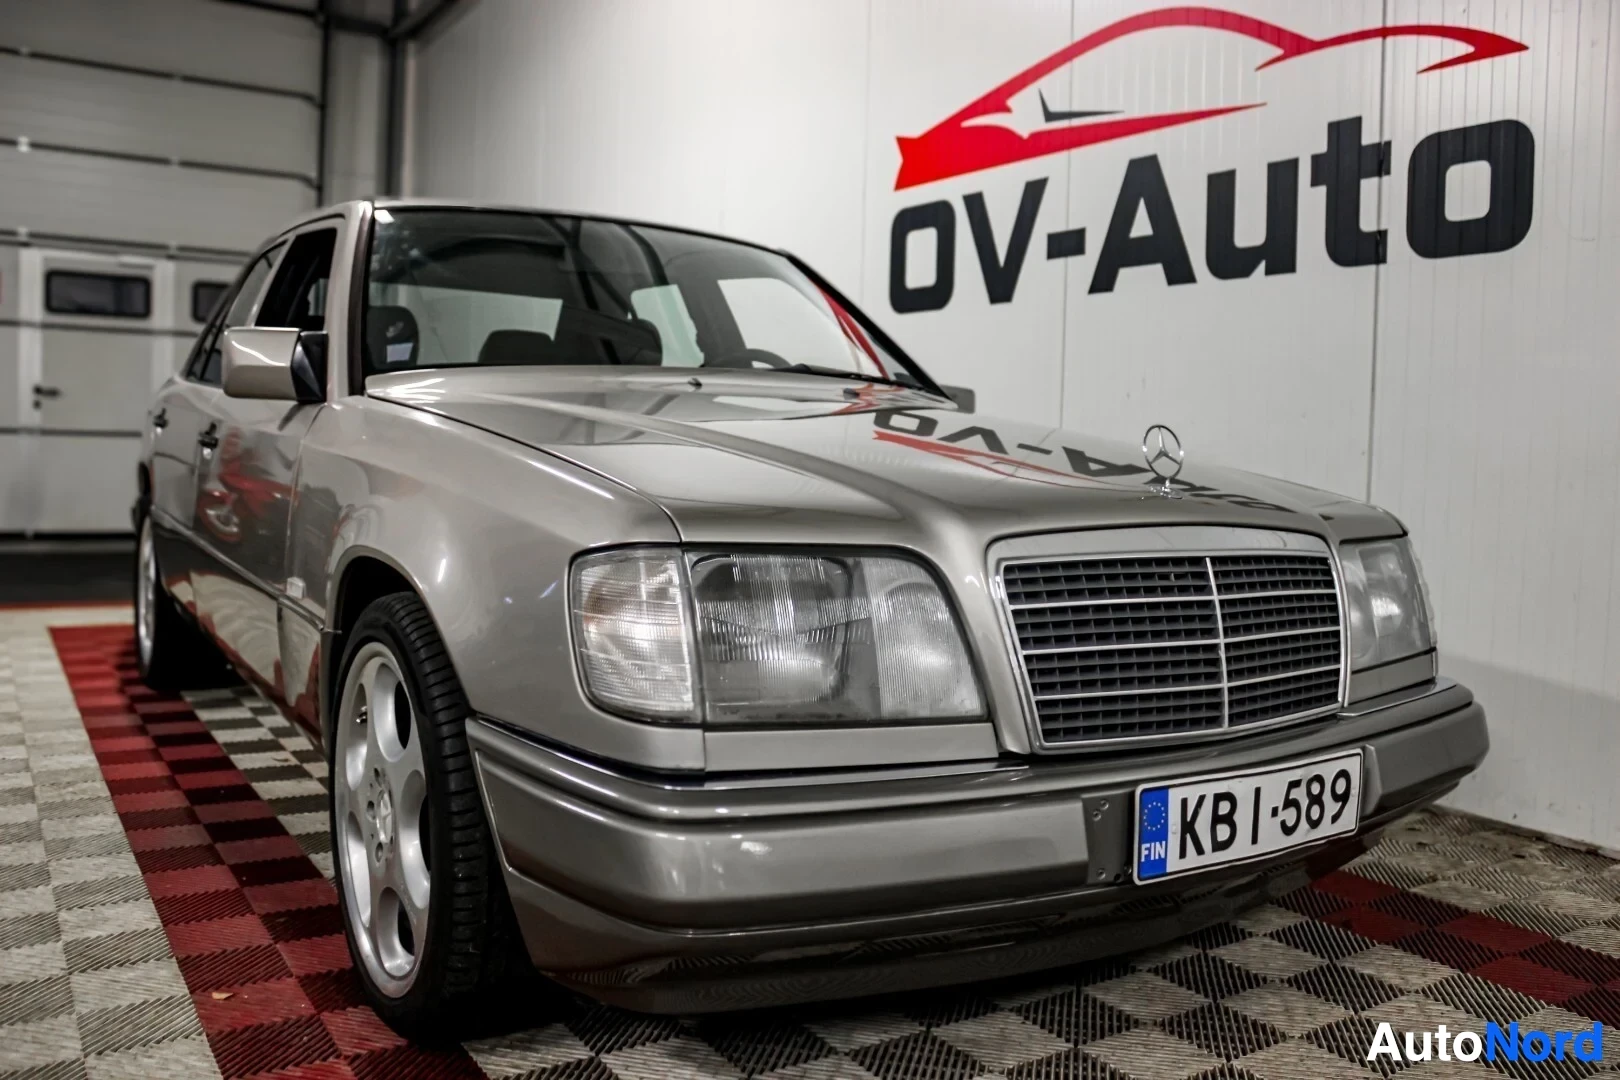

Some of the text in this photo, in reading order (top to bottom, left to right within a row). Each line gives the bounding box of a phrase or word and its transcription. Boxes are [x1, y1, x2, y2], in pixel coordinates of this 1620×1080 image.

[889, 115, 1535, 314] OV-Auto
[1140, 840, 1166, 862] FIN
[1179, 769, 1352, 859] KBI-589
